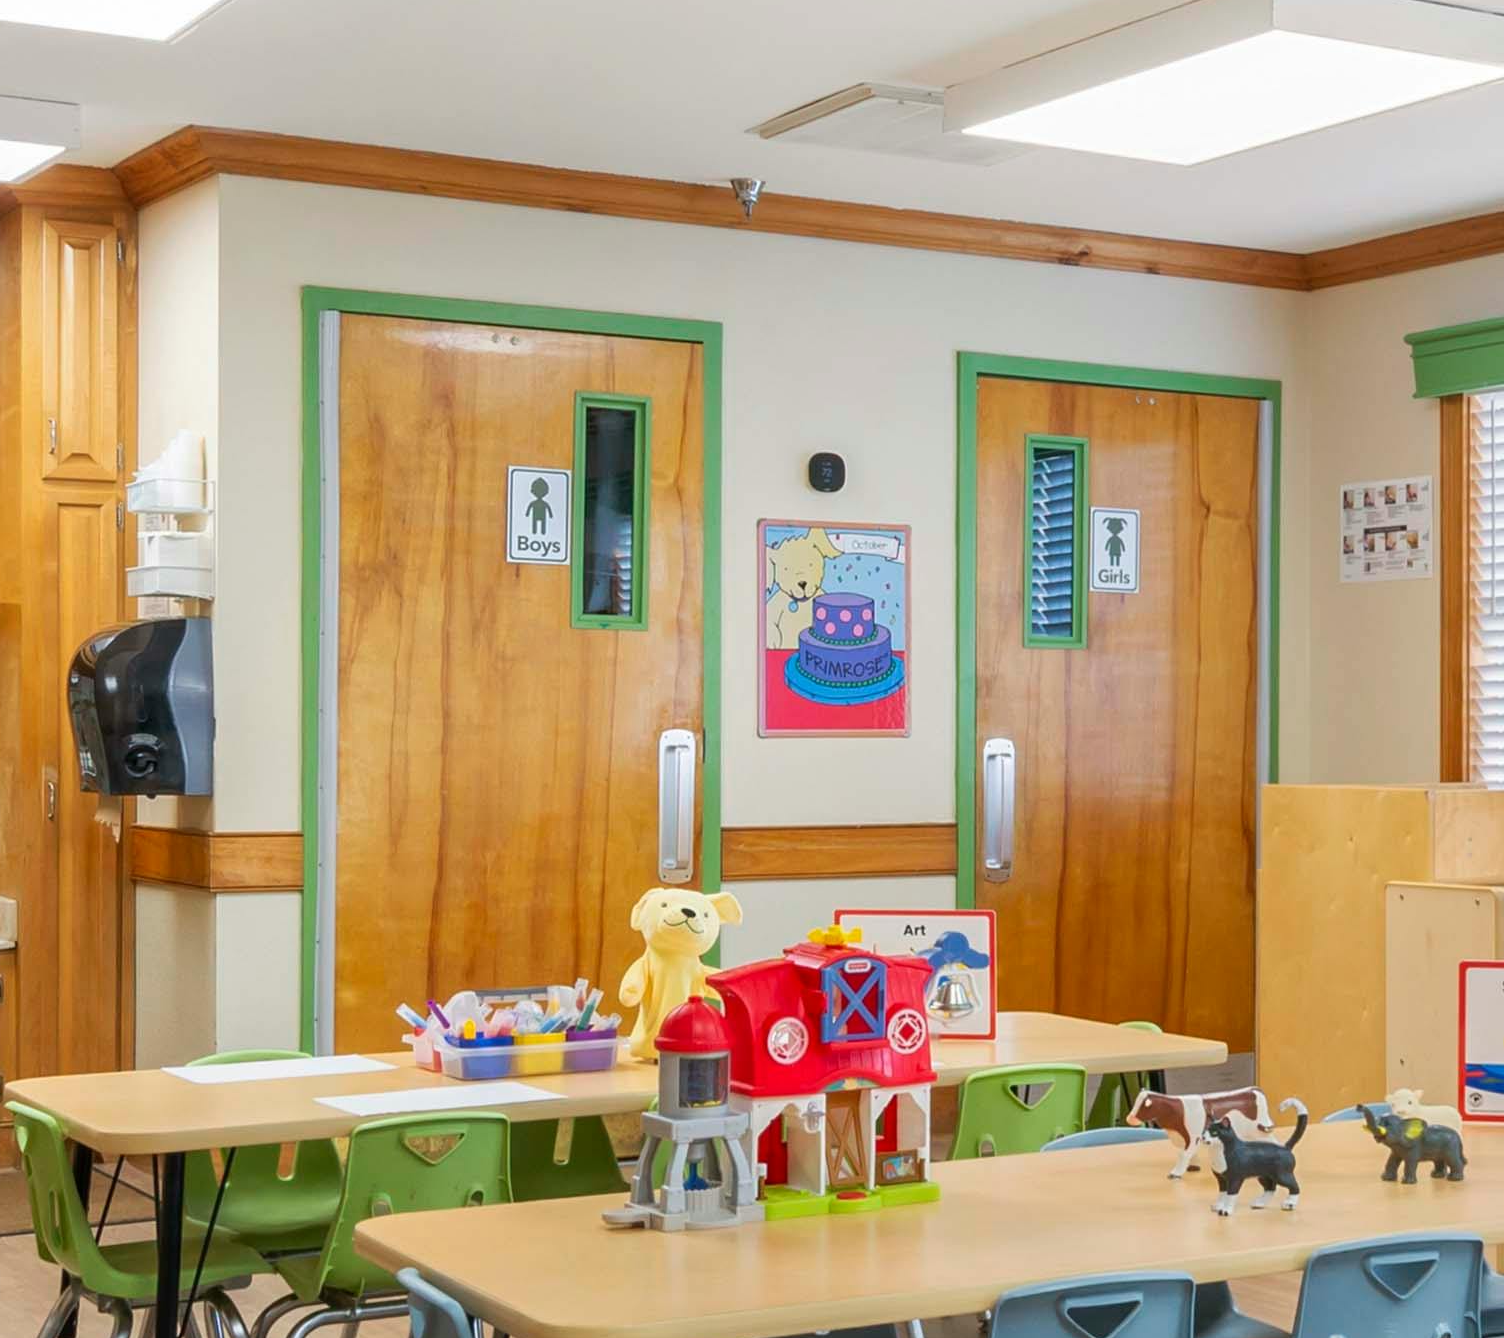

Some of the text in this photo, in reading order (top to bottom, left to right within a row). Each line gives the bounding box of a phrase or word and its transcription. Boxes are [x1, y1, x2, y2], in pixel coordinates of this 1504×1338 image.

[517, 535, 561, 557] Boys
[851, 540, 889, 550] October
[1098, 568, 1130, 584] Girls
[904, 925, 926, 936] Art
